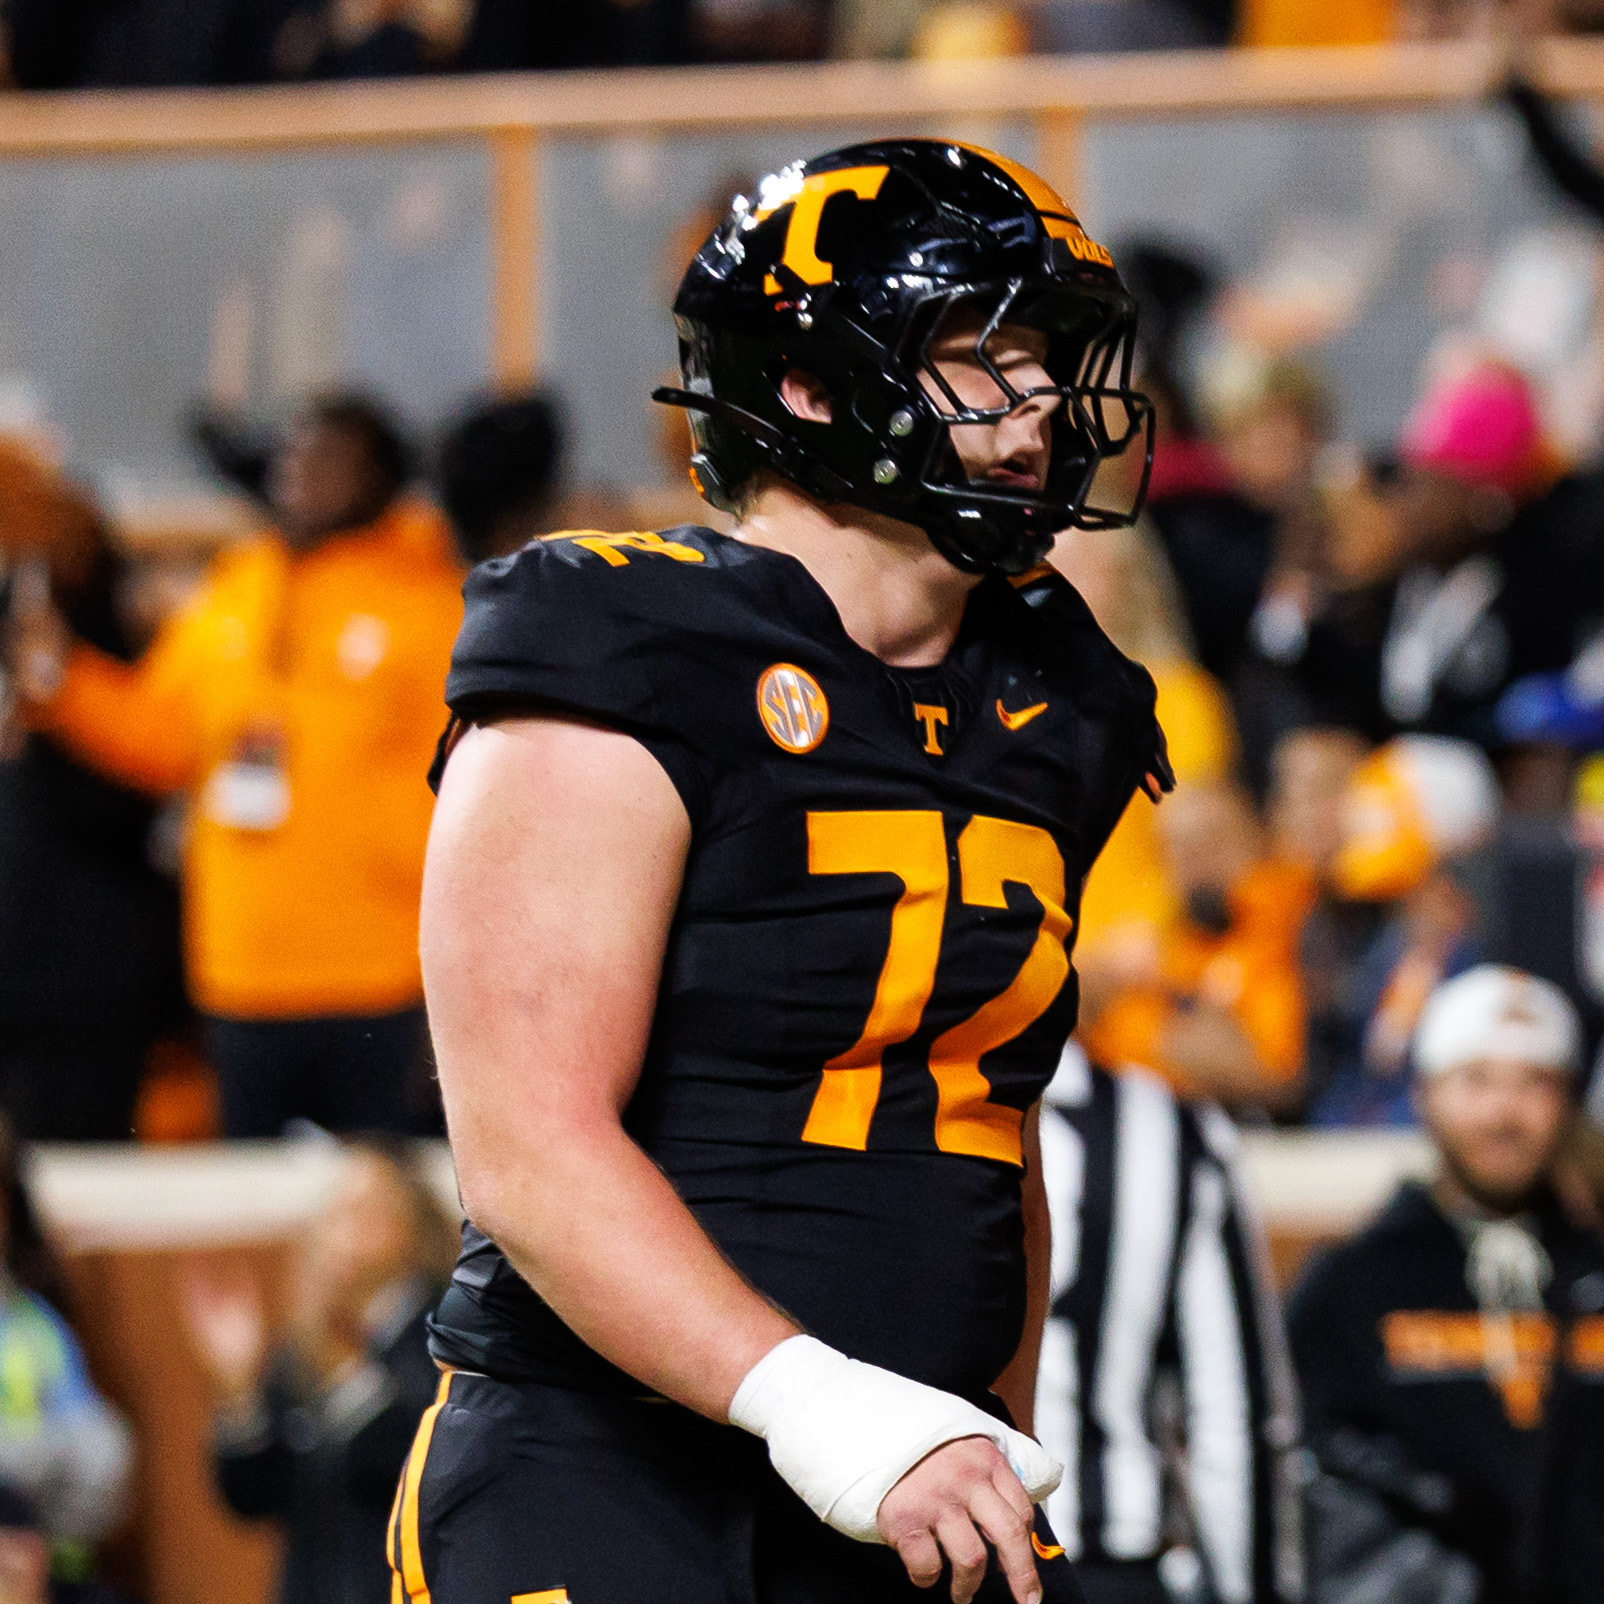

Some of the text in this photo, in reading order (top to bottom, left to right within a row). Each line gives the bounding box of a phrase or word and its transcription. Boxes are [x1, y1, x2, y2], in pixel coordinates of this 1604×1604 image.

[754, 164, 890, 296] T
[763, 668, 824, 749] SEC
[914, 703, 949, 756] T
[801, 809, 1073, 1168] 72
